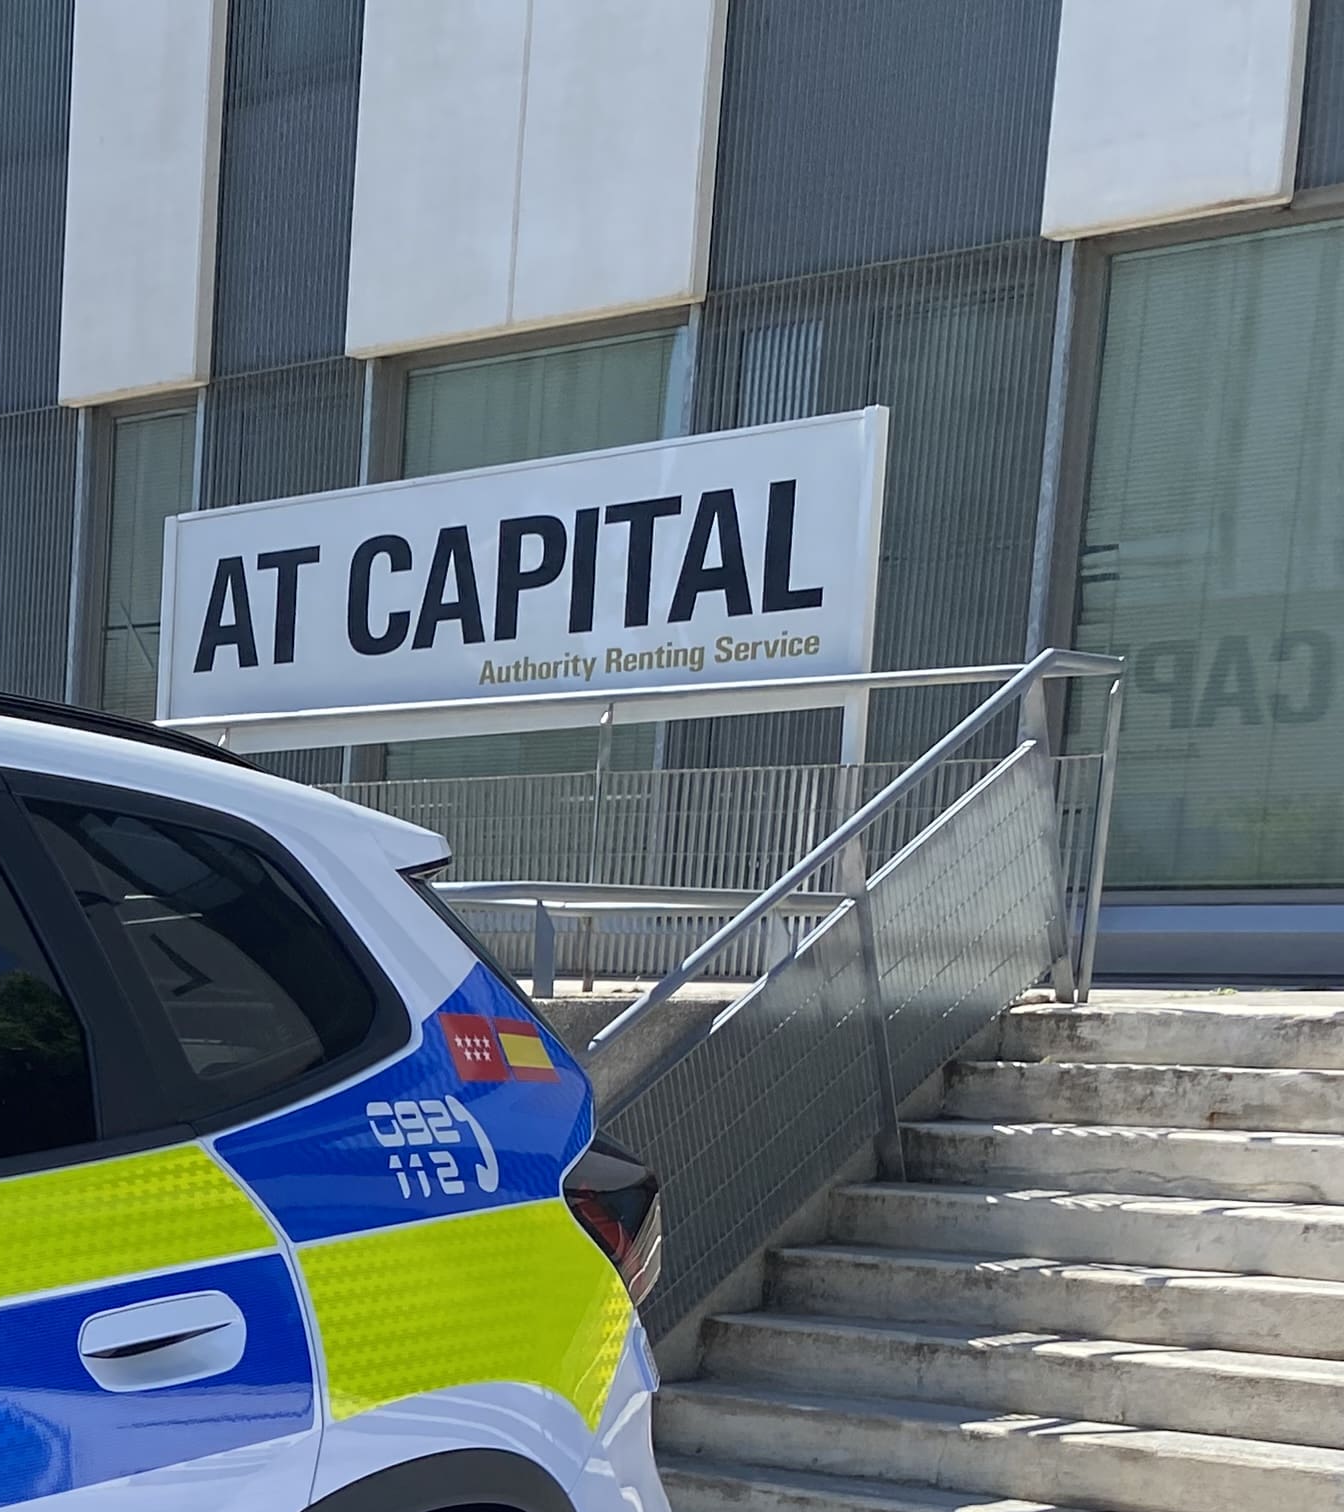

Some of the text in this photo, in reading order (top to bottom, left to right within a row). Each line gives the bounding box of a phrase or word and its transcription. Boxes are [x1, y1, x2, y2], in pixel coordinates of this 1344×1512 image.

[193, 479, 824, 673] AT CAPITAL
[478, 630, 820, 686] Authority Renting Service
[366, 1098, 461, 1148] 092
[389, 1150, 466, 1199] 112
